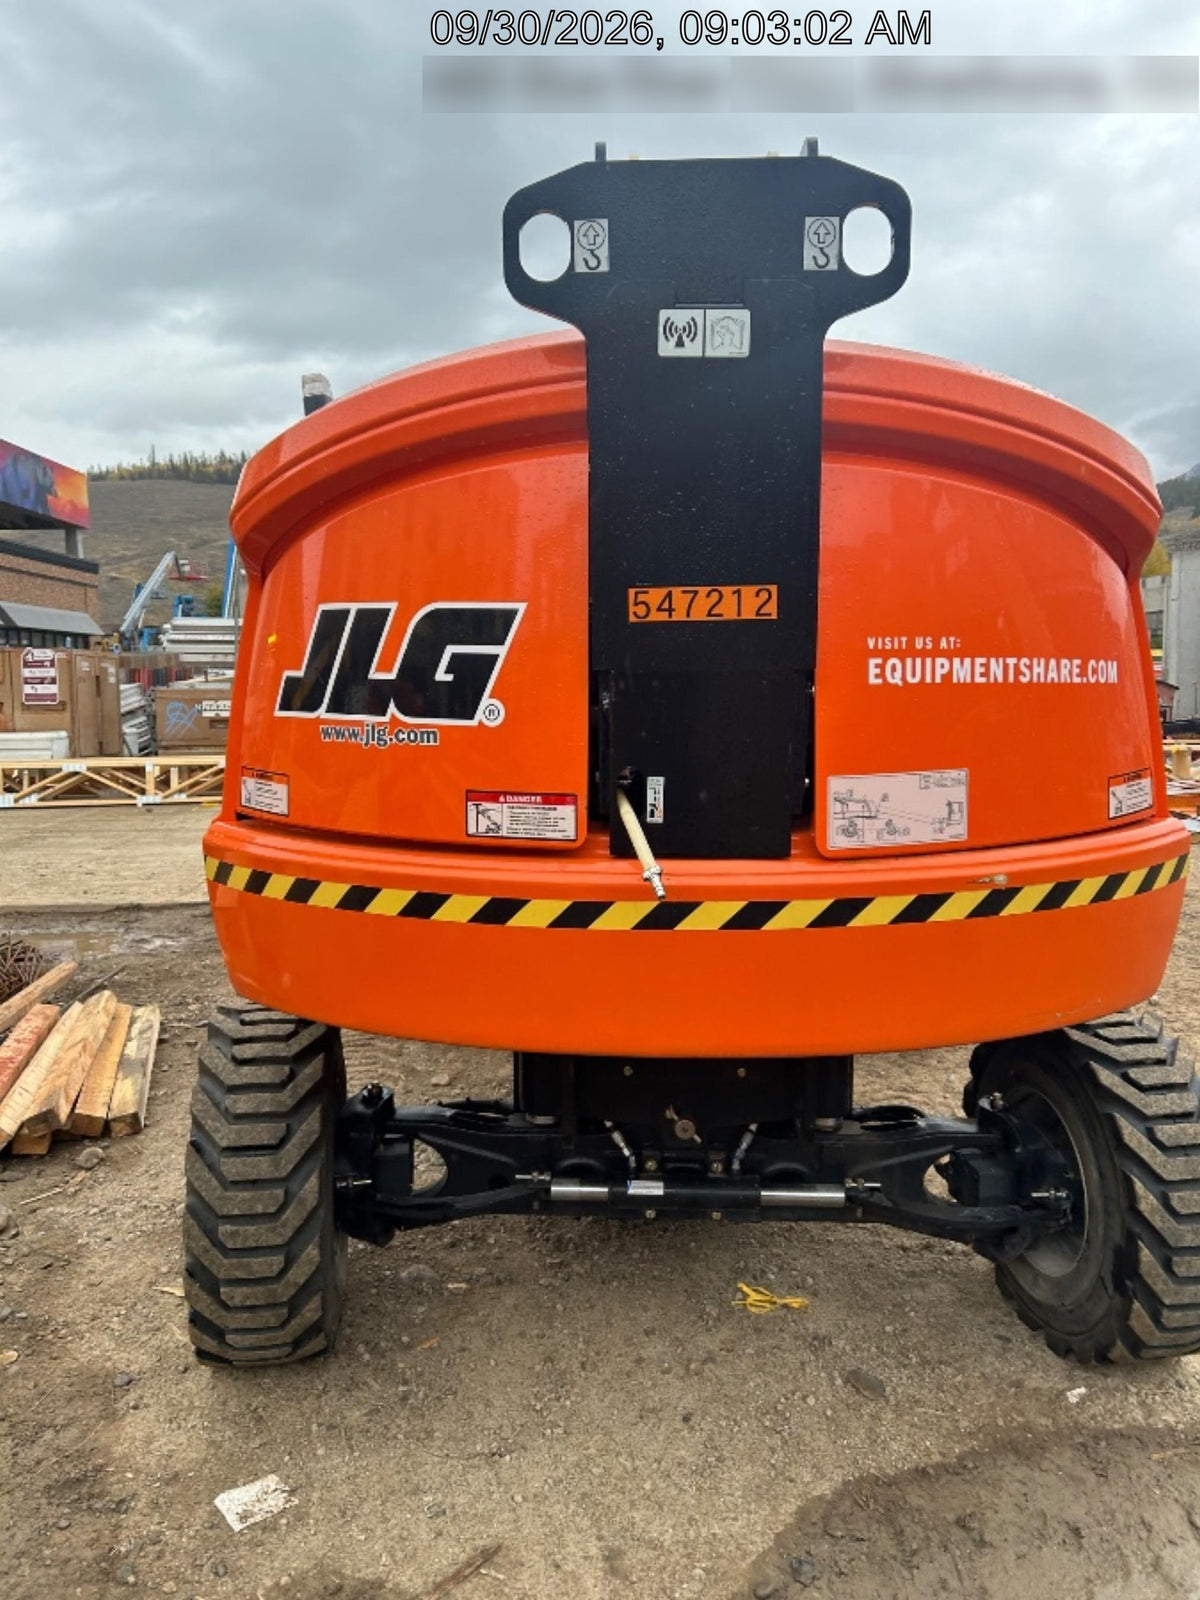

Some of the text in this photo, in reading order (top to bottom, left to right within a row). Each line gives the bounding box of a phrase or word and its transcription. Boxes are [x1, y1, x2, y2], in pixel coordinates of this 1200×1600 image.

[632, 588, 773, 619] 547212
[867, 637, 961, 650] VISIT US AT:
[274, 602, 528, 726] JLG
[868, 657, 1118, 686] EQUIPMENTSHARE.COM
[320, 722, 439, 748] www.jlg.com
